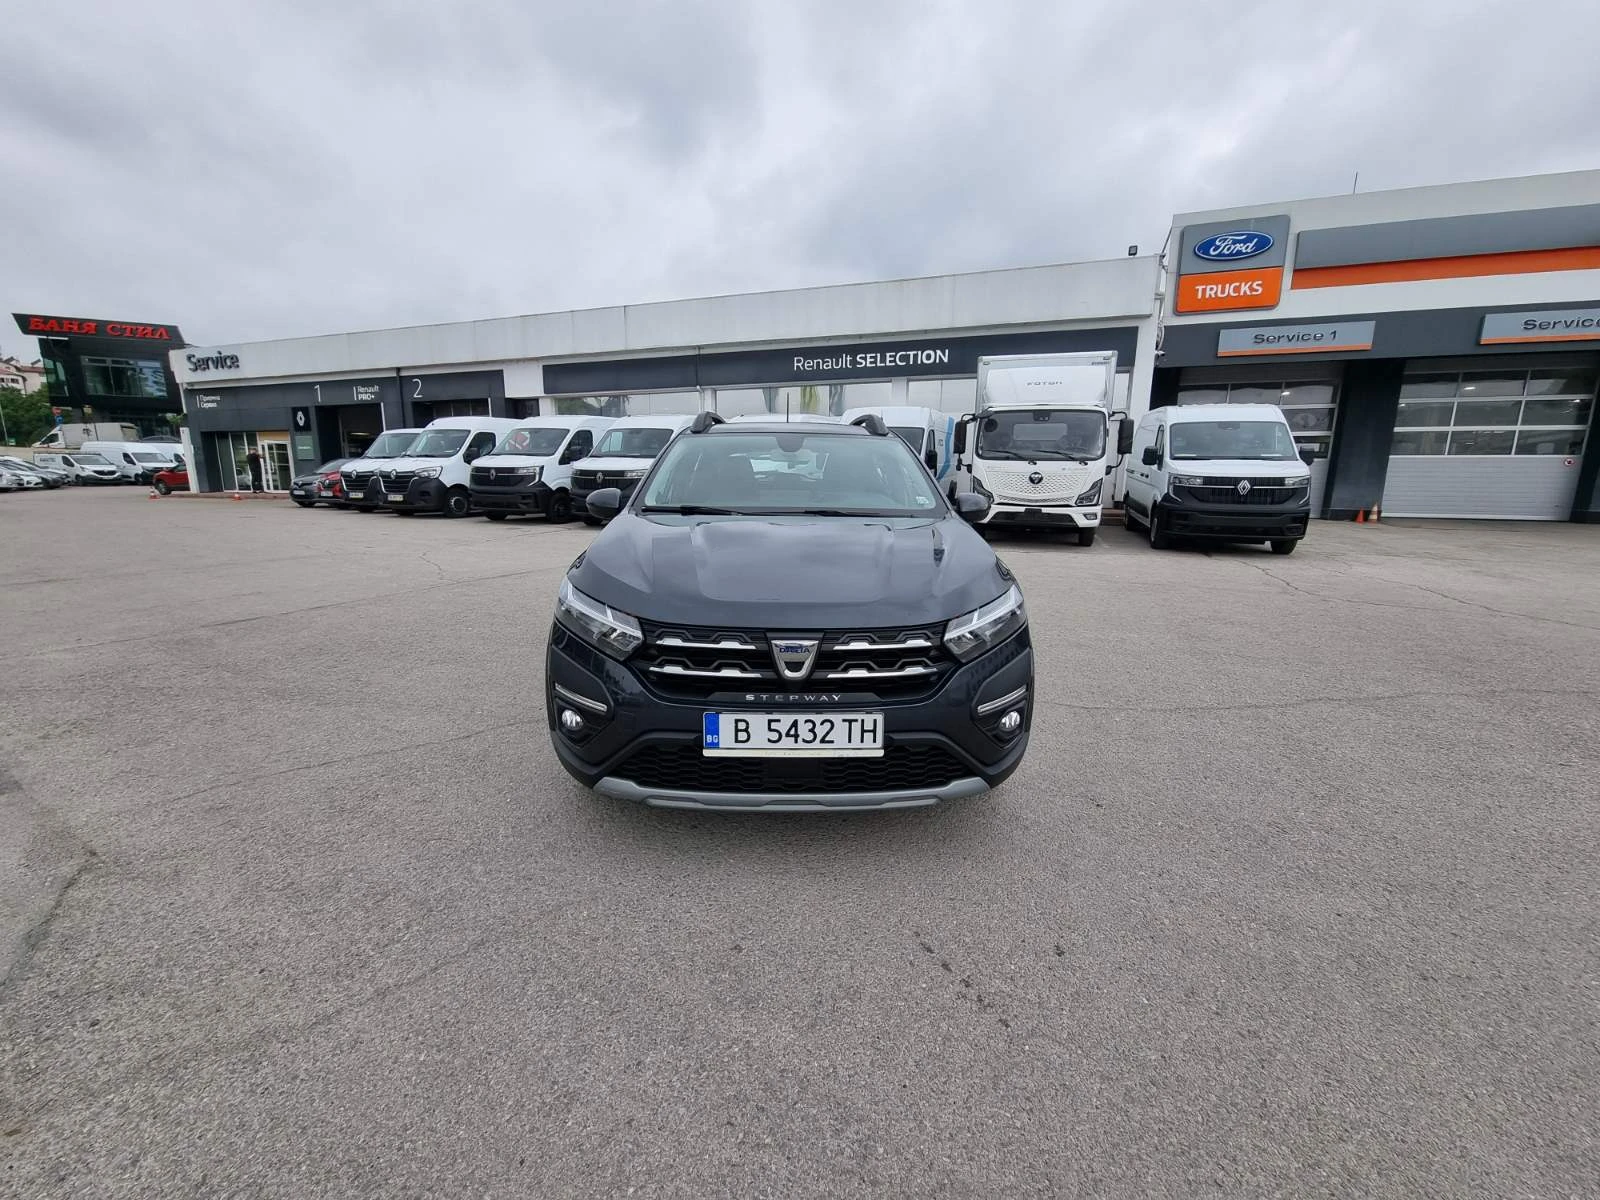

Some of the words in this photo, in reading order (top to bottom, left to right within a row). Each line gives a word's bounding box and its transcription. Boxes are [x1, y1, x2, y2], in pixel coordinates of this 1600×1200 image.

[1209, 234, 1258, 256] Ford
[1195, 280, 1263, 299] TRUCKS
[29, 317, 97, 334] БАНЯ
[106, 322, 170, 340] СТИЛ
[1253, 332, 1324, 344] Service
[1329, 330, 1337, 341] 1
[186, 350, 240, 372] Service
[793, 353, 852, 371] Renault
[856, 349, 949, 368] SELECTION
[314, 384, 321, 402] 1
[357, 385, 380, 393] Renault
[412, 378, 423, 398] 2
[706, 735, 719, 743] BG
[734, 718, 751, 744] B
[767, 718, 835, 744] 5432
[841, 718, 878, 744] TH
